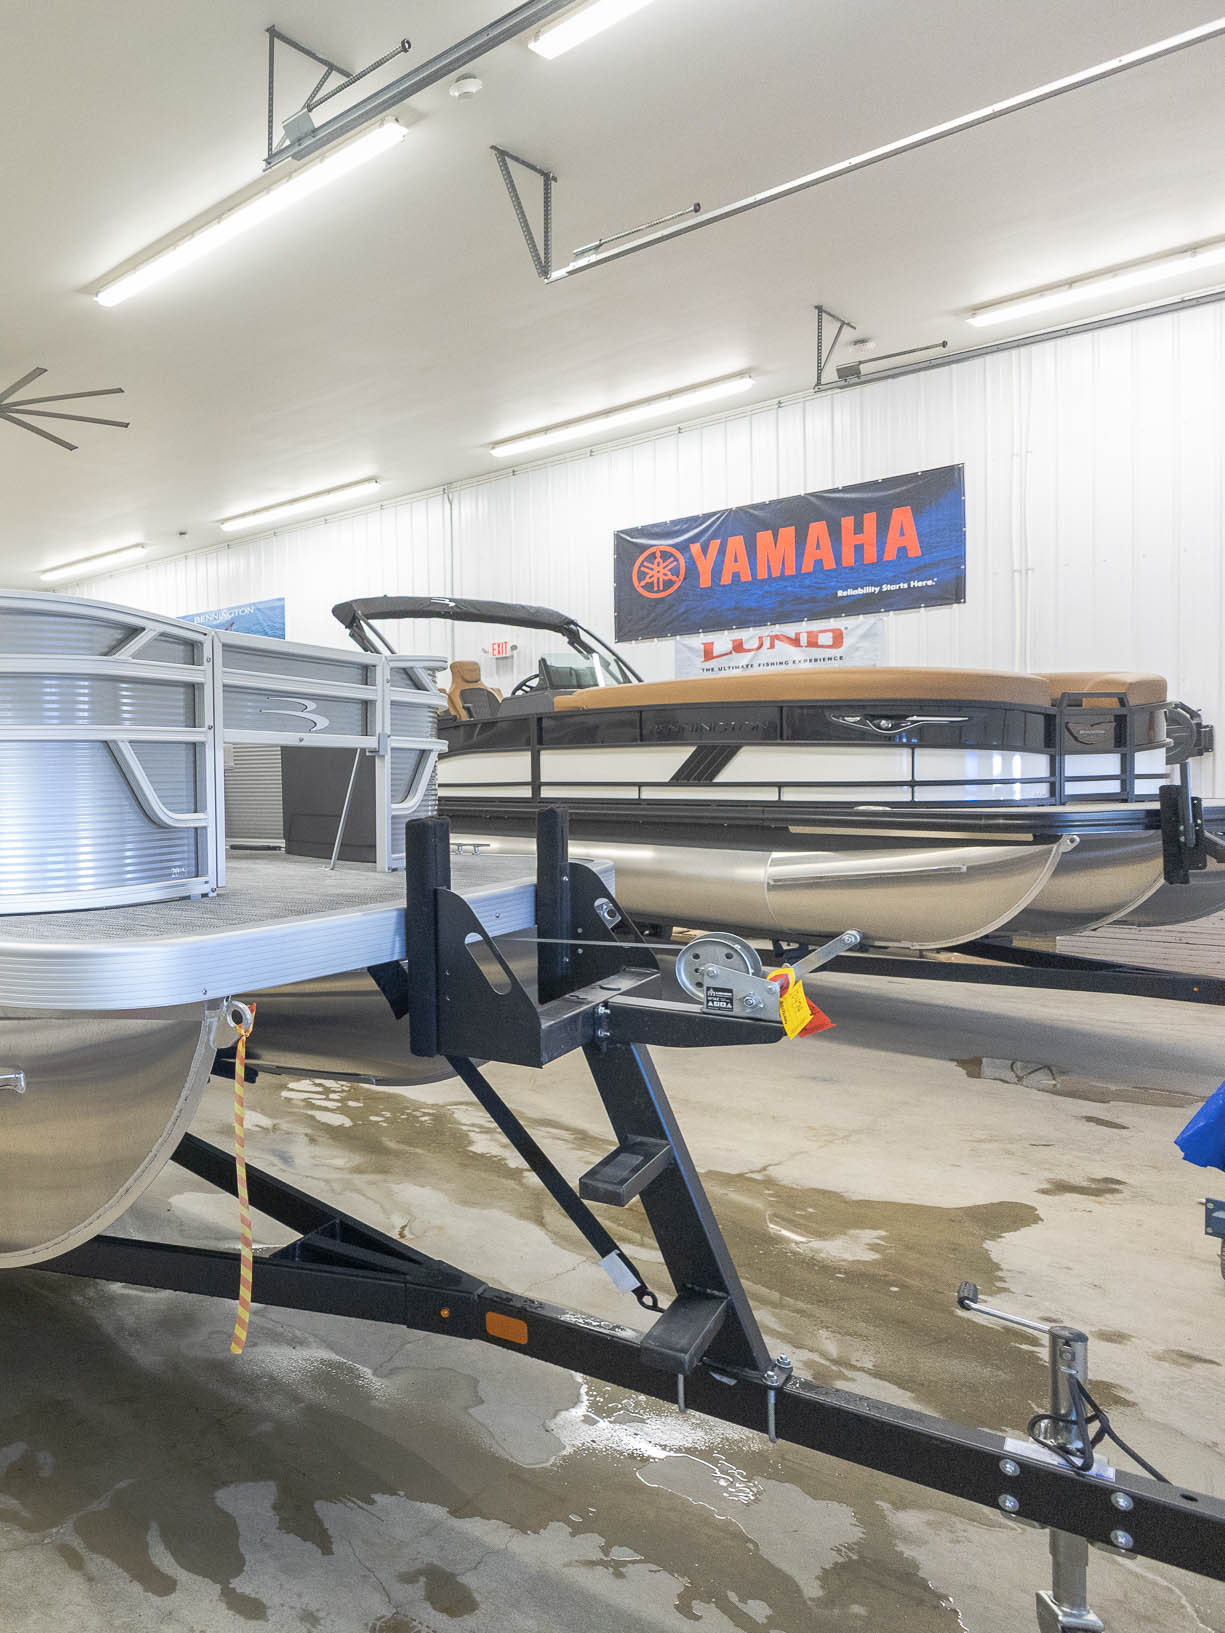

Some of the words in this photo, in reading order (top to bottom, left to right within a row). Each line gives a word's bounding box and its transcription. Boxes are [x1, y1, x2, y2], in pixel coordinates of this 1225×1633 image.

[690, 506, 922, 588] YAMAHA
[837, 586, 880, 597] Reliability
[882, 582, 908, 592] Starts
[492, 641, 508, 656] EXIT
[701, 628, 844, 663] LUND
[718, 663, 755, 672] ULTIMATE
[758, 660, 790, 668] FISHING
